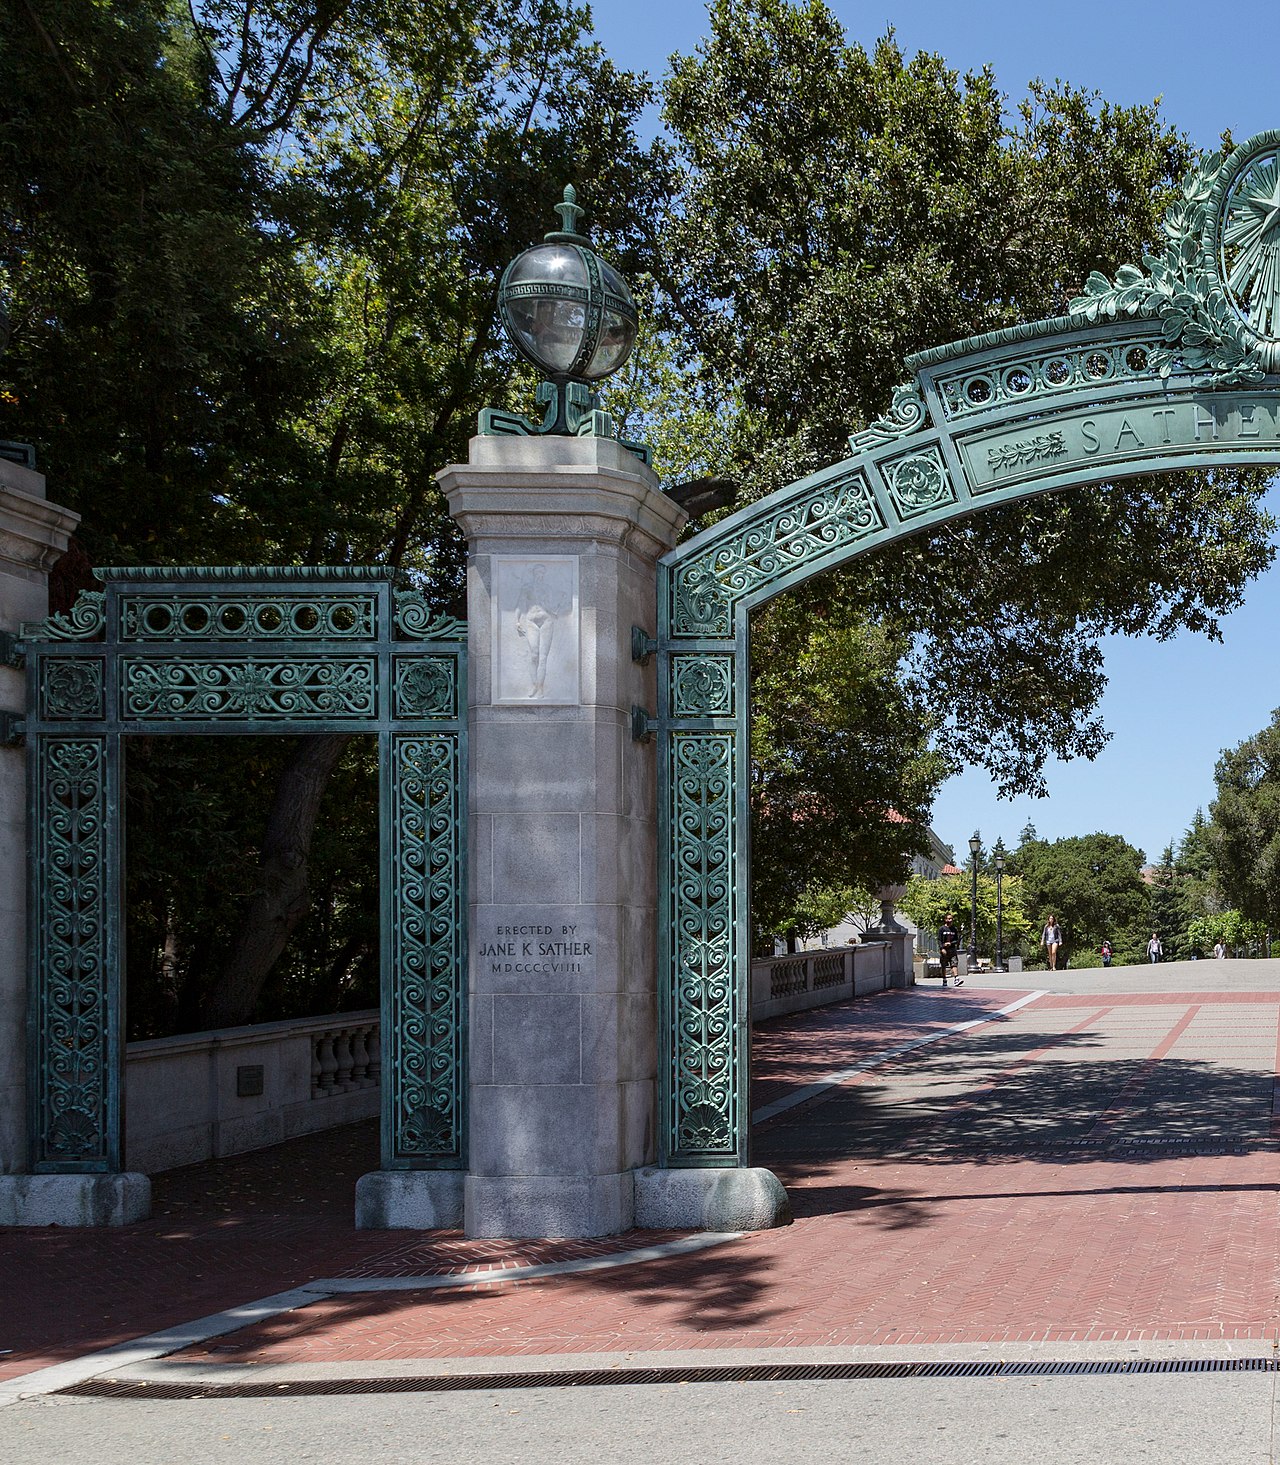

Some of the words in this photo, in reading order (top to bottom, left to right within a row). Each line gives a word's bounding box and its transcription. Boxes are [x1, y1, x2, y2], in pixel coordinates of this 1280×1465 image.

[497, 925, 553, 935] ERECTED
[562, 925, 577, 935] BY
[479, 943, 516, 956] JANE
[522, 943, 533, 956] K
[539, 942, 593, 956] SATHER
